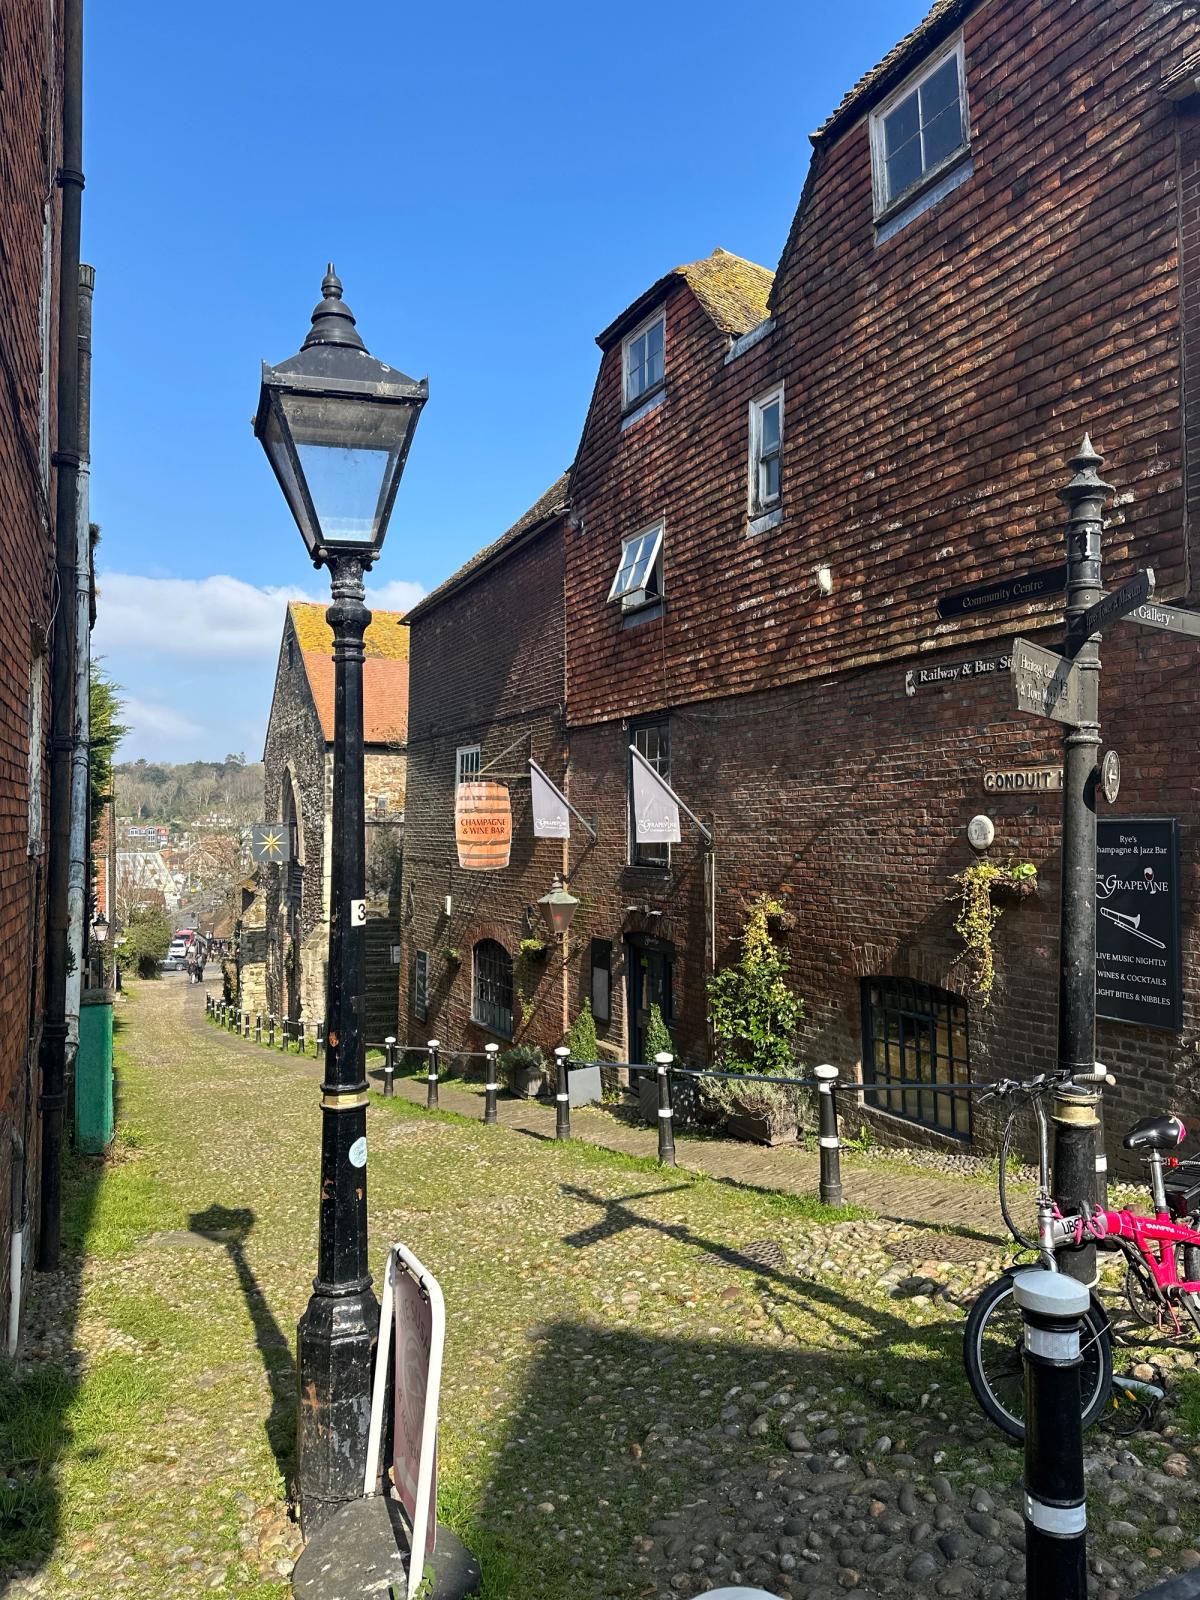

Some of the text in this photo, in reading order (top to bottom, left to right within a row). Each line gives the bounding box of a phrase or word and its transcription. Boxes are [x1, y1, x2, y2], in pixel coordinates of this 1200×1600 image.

[962, 580, 1044, 608] Community Centre
[1139, 605, 1171, 626] Gallery
[919, 668, 959, 684] Railway
[962, 663, 972, 675] &
[975, 660, 995, 673] Bus
[985, 770, 1052, 789] CONDUIT
[461, 818, 507, 827] CHAMPAGNE
[462, 826, 505, 835] & WINE BAR
[1120, 835, 1137, 844] Rye's
[1096, 846, 1167, 856] hampagne & Jazz Bar
[358, 903, 366, 921] 3
[1096, 952, 1167, 967] LIVE MUSIC NIGHTLY
[1097, 970, 1167, 986] WINES & COCKTAILS
[1115, 990, 1134, 1000] BITES
[1135, 993, 1140, 1001] &
[1141, 995, 1171, 1006] NIBBLES
